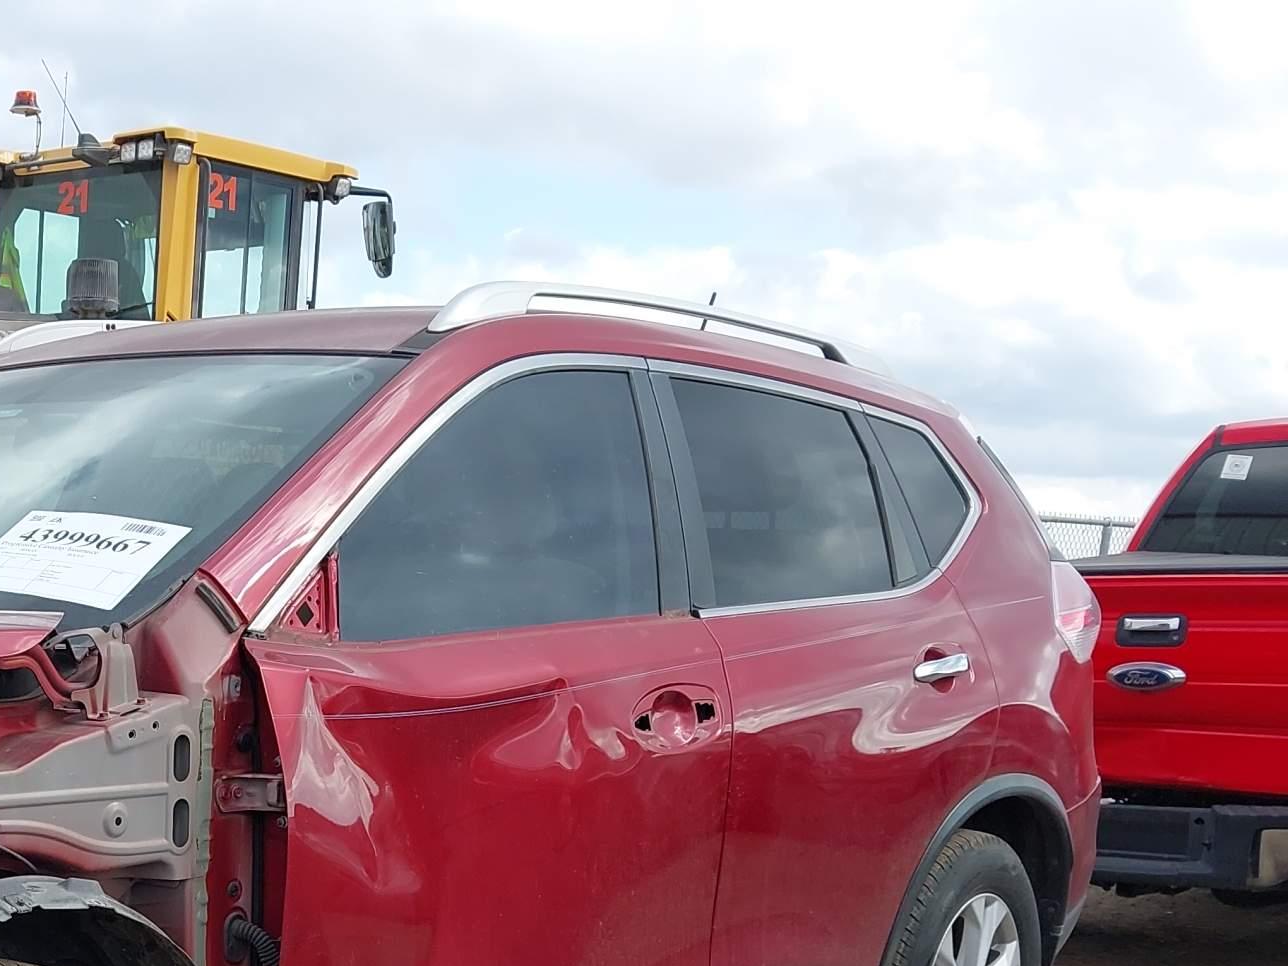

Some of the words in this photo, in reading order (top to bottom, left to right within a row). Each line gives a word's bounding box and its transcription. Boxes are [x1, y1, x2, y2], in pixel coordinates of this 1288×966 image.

[57, 179, 89, 214] 21
[207, 173, 237, 211] 21
[19, 527, 152, 556] 43999667
[1123, 670, 1159, 685] Ford
